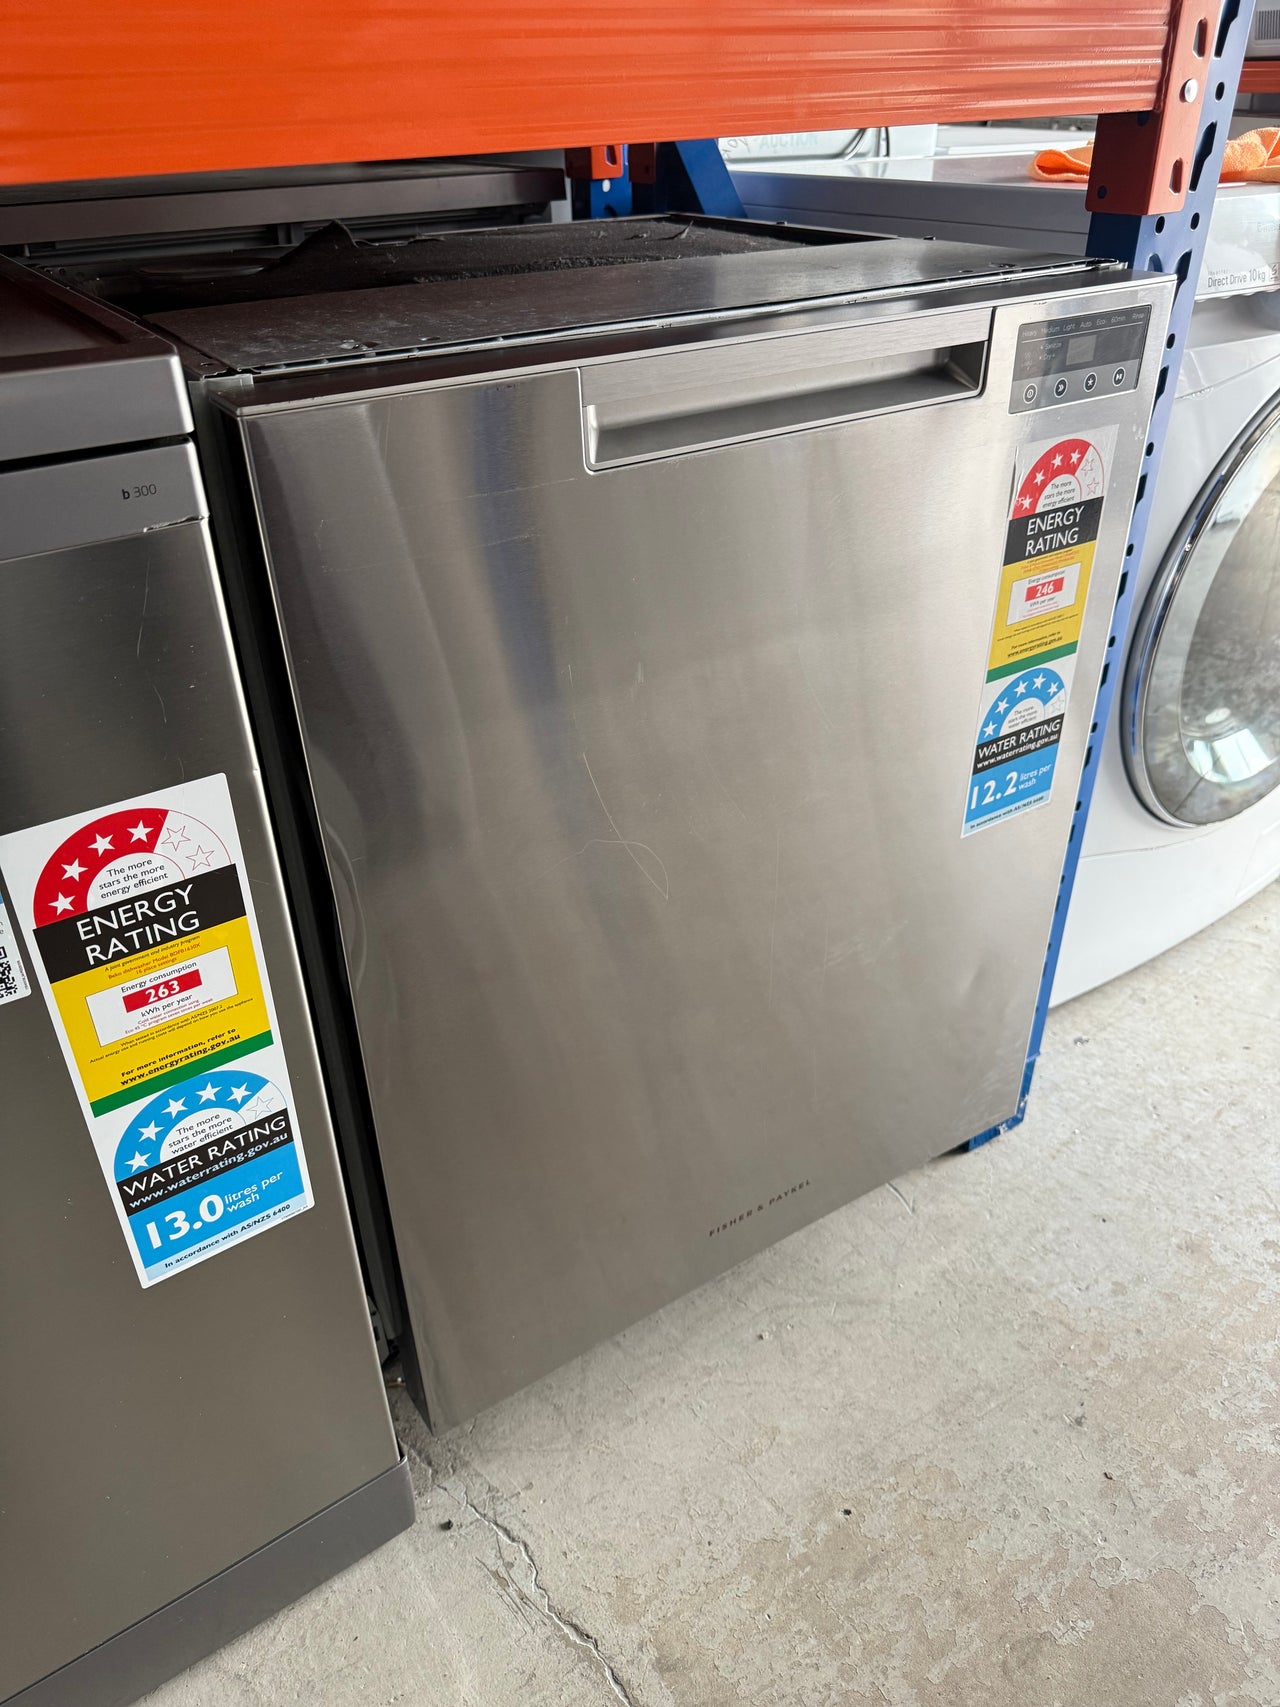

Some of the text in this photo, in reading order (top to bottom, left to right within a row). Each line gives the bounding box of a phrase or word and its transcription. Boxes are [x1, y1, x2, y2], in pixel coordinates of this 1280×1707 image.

[1208, 276, 1228, 288] Direct
[1229, 274, 1247, 285] Drive
[1063, 323, 1076, 332] Light
[122, 483, 157, 500] b 300
[1044, 492, 1055, 500] stars
[1060, 480, 1072, 488] more
[1042, 496, 1075, 509] energy efficient
[1027, 505, 1085, 536] ENERGY
[1025, 527, 1079, 557] RATING
[1035, 581, 1055, 598] 246
[976, 733, 1059, 769] www.waterrating.gov.au
[978, 719, 1061, 759] WATER RATING
[970, 764, 1052, 810] 12.2 litres per
[1018, 778, 1037, 790] wash
[99, 864, 165, 890] stars the more
[106, 858, 153, 878] The more
[100, 872, 168, 899] energy efficient
[76, 883, 194, 941] ENERGY
[85, 910, 200, 966] RATING
[110, 962, 121, 972] joint
[122, 953, 150, 967] government
[150, 948, 160, 956] and
[161, 942, 179, 953] industry
[180, 935, 200, 946] program
[152, 954, 168, 963] Model
[121, 961, 197, 994] Energy consumption
[145, 980, 180, 1003] 263
[140, 993, 193, 1017] kWh per year
[120, 1039, 135, 1047] When
[121, 1067, 135, 1077] For
[136, 1059, 157, 1071] more
[158, 1040, 206, 1063] information,
[207, 1031, 226, 1043] refer
[120, 1033, 241, 1086] www.energyrating.gov.au
[168, 1116, 232, 1148] stars the more
[170, 1124, 234, 1155] water efficient
[175, 1114, 220, 1136] The more
[122, 1116, 286, 1197] WATER RATING
[129, 1132, 289, 1209] www.waterrating.gov.au
[146, 1171, 284, 1250] 13.0 litres per
[226, 1191, 260, 1213] wash
[709, 1209, 753, 1237] FISHER
[768, 1179, 811, 1206] PAYKEL
[164, 1260, 174, 1269] In
[175, 1238, 220, 1264] accordance
[221, 1228, 239, 1241] with
[240, 1213, 272, 1232] AS/NZS
[272, 1203, 291, 1216] 6400
